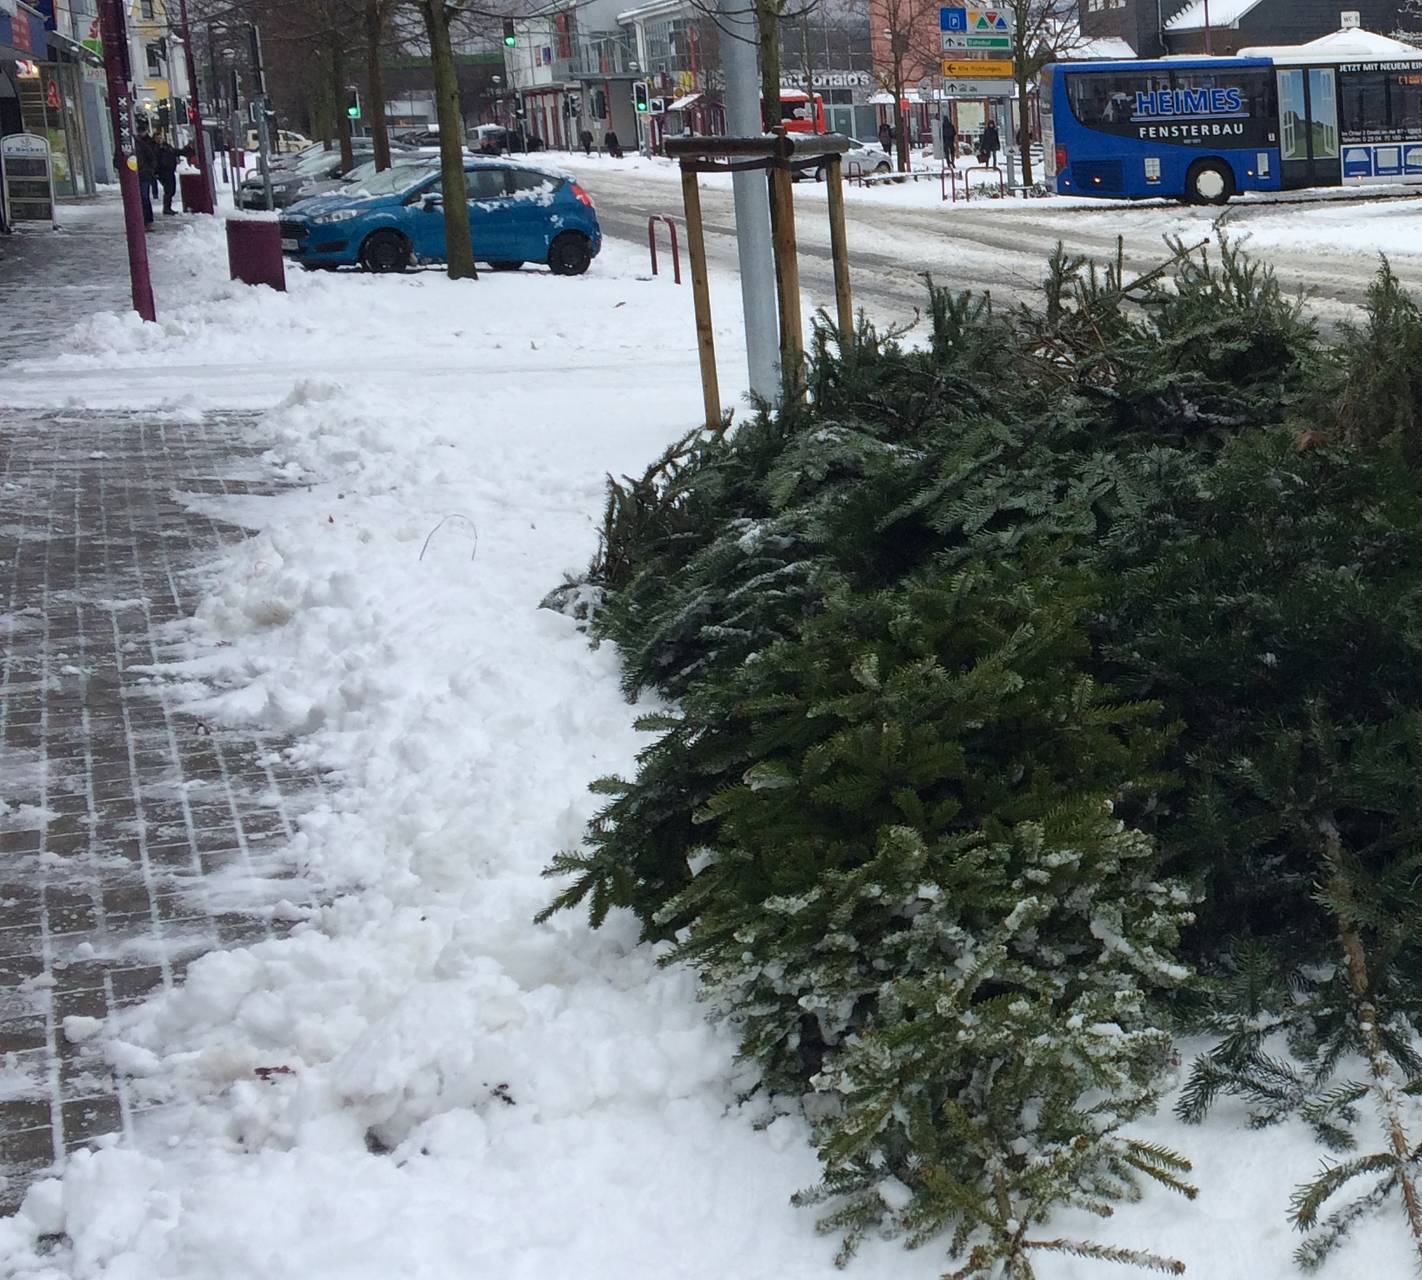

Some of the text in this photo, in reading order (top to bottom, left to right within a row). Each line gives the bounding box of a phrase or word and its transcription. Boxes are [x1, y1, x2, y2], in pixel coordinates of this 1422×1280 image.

[1339, 64, 1361, 72] JETZT
[1362, 63, 1379, 71] MIT
[1380, 61, 1410, 71] NEUEM
[1135, 87, 1242, 116] HEIMES
[1139, 123, 1244, 138] FENSTERBAU
